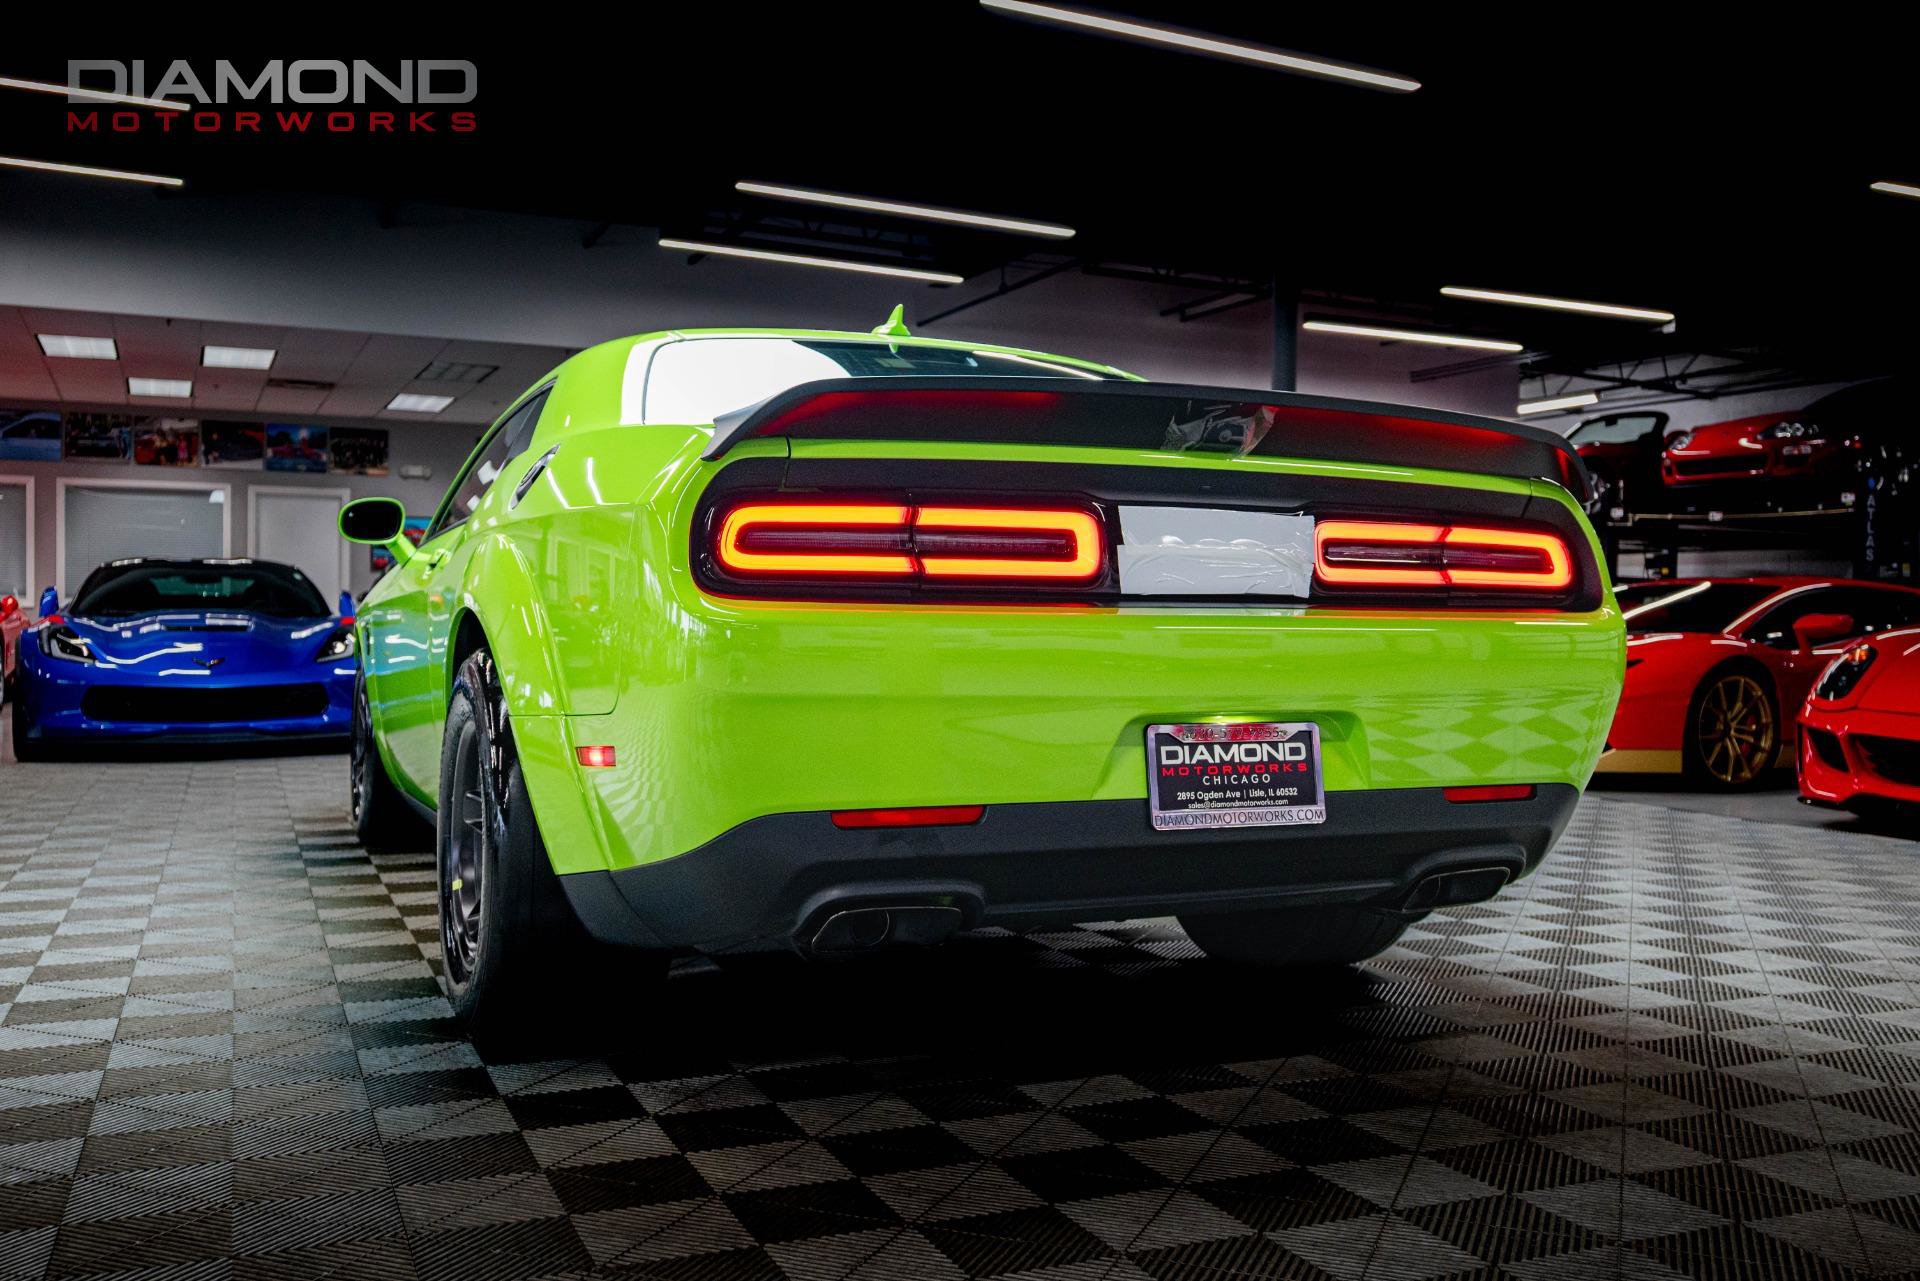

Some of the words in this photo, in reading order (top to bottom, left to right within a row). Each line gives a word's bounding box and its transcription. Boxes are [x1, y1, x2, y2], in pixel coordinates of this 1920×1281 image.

[1866, 494, 1876, 561] ATLAS
[1161, 742, 1307, 765] DIAMOND
[1162, 763, 1308, 777] MOTORWORKS
[1202, 774, 1271, 786] CHICAGO
[1177, 791, 1195, 800] 2895
[1197, 790, 1224, 801] Ogden
[1225, 789, 1241, 798] Ave
[1249, 788, 1267, 798] Lisle,
[1268, 788, 1275, 797] IL
[1276, 787, 1298, 797] 60532
[1188, 798, 1289, 809] sales@diamondmotorworks.com
[1154, 808, 1325, 827] DIAMONDMOTORWORKS.COM
